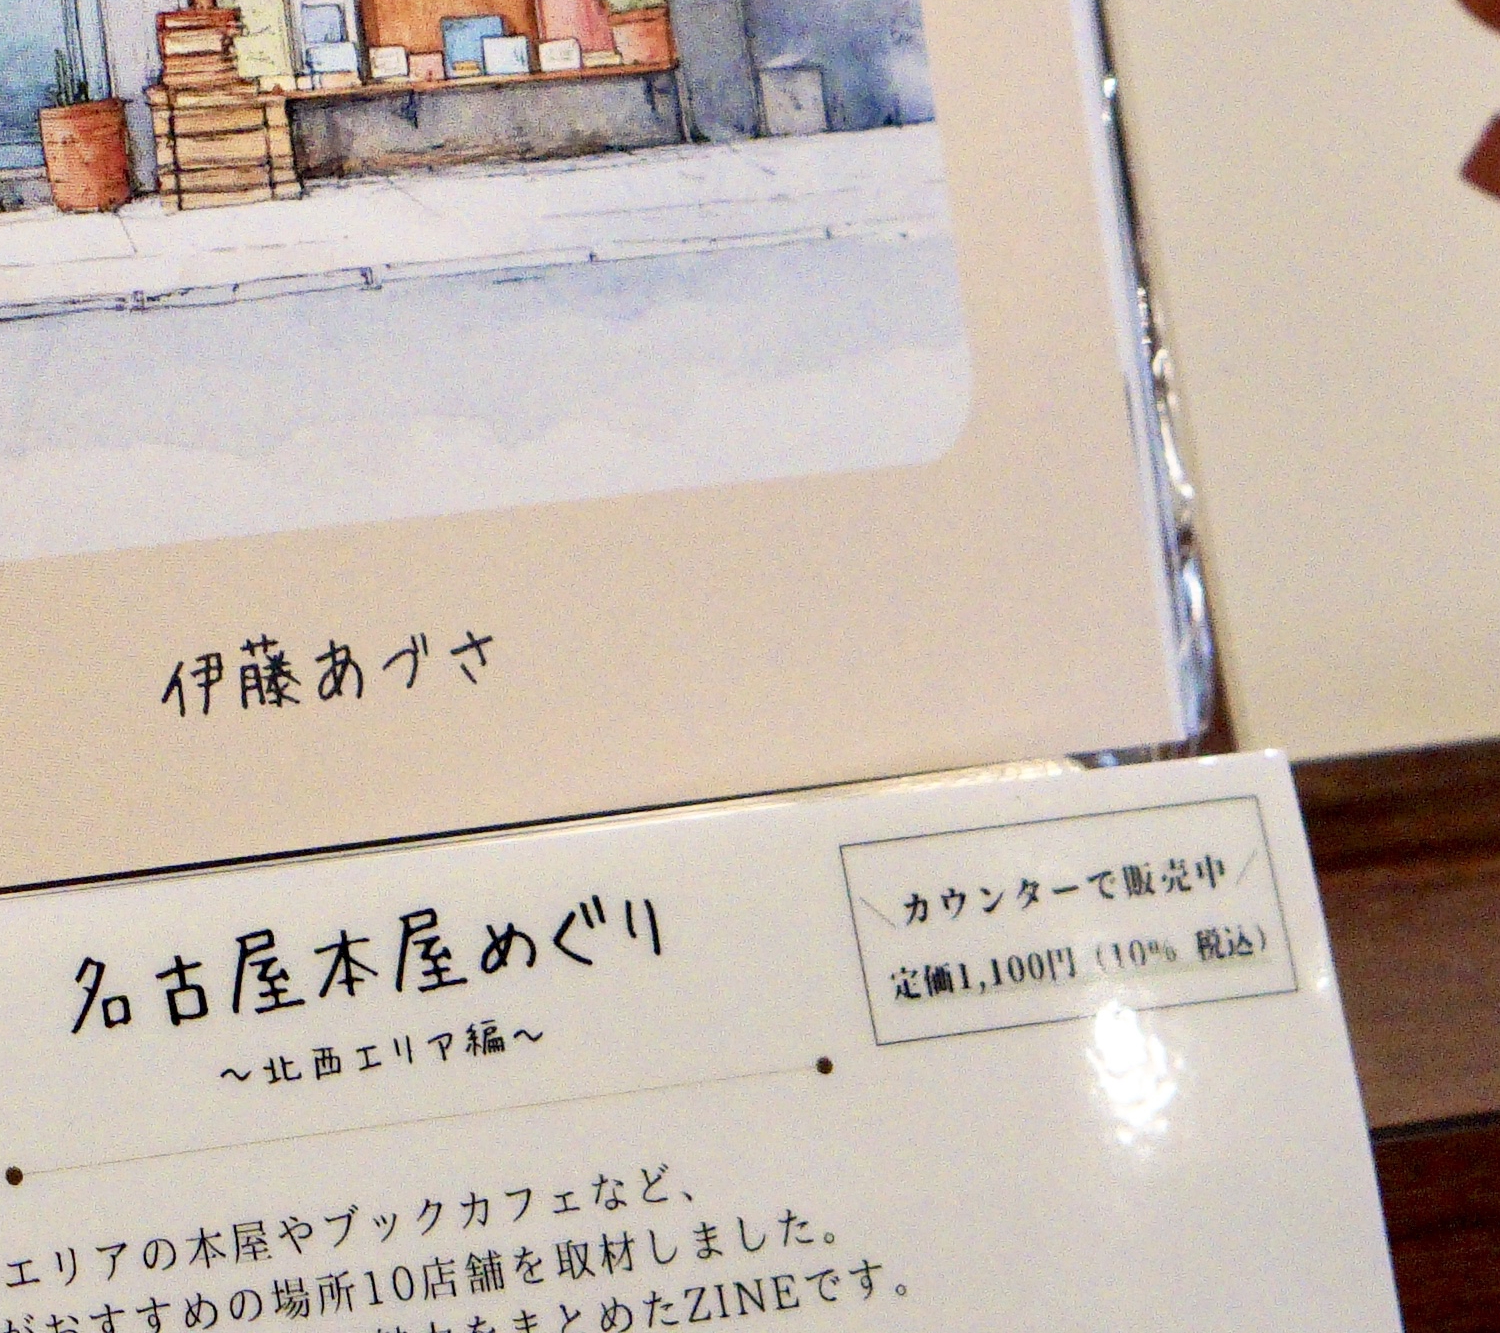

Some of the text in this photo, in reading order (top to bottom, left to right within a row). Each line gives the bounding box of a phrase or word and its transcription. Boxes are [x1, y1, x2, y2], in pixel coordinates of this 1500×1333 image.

[159, 629, 495, 719] 伊藤あづさ
[902, 853, 1228, 927] カウンターで販売中
[69, 892, 666, 1037] 名古屋本屋めぐり
